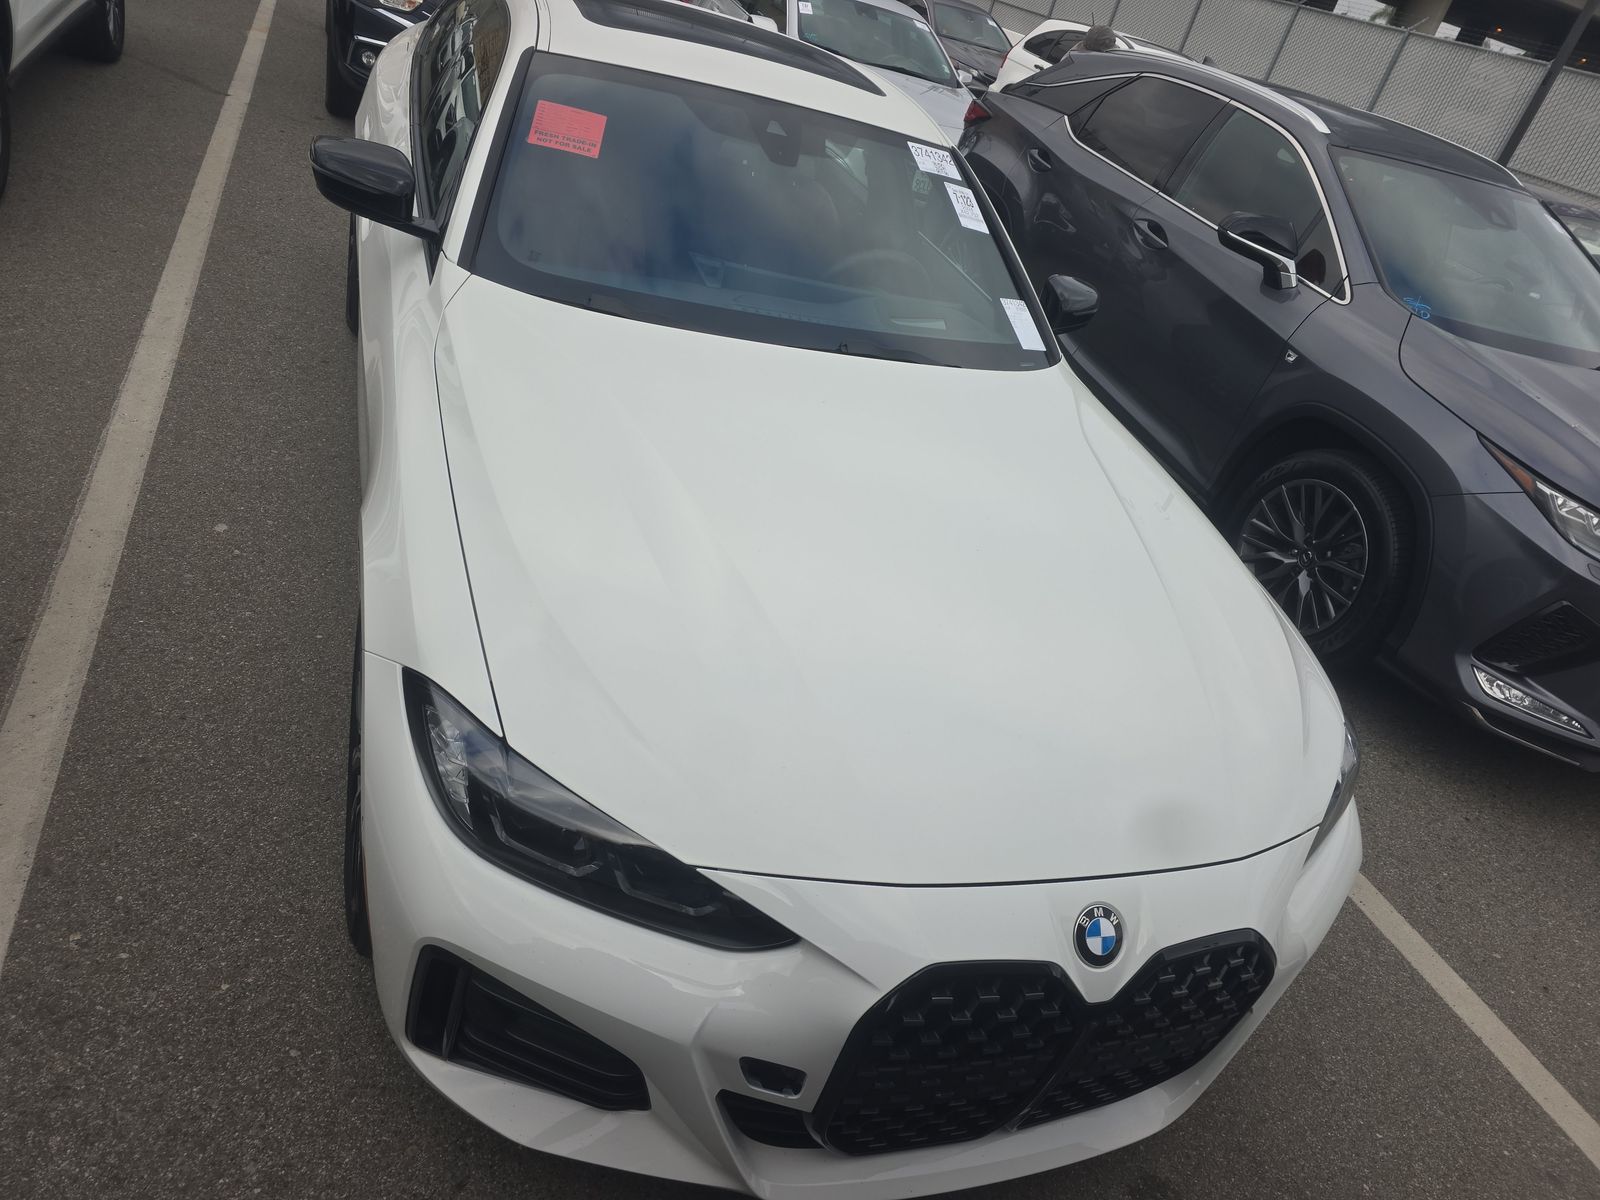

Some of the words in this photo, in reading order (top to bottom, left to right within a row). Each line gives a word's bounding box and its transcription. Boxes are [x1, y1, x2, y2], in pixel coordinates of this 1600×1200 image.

[534, 130, 560, 139] FRESH
[561, 135, 597, 148] TRADE-IN
[536, 136, 552, 144] NOT
[555, 140, 570, 148] FOR
[572, 144, 593, 153] SALE
[911, 145, 954, 167] 3741342
[1079, 907, 1119, 928] BMW
